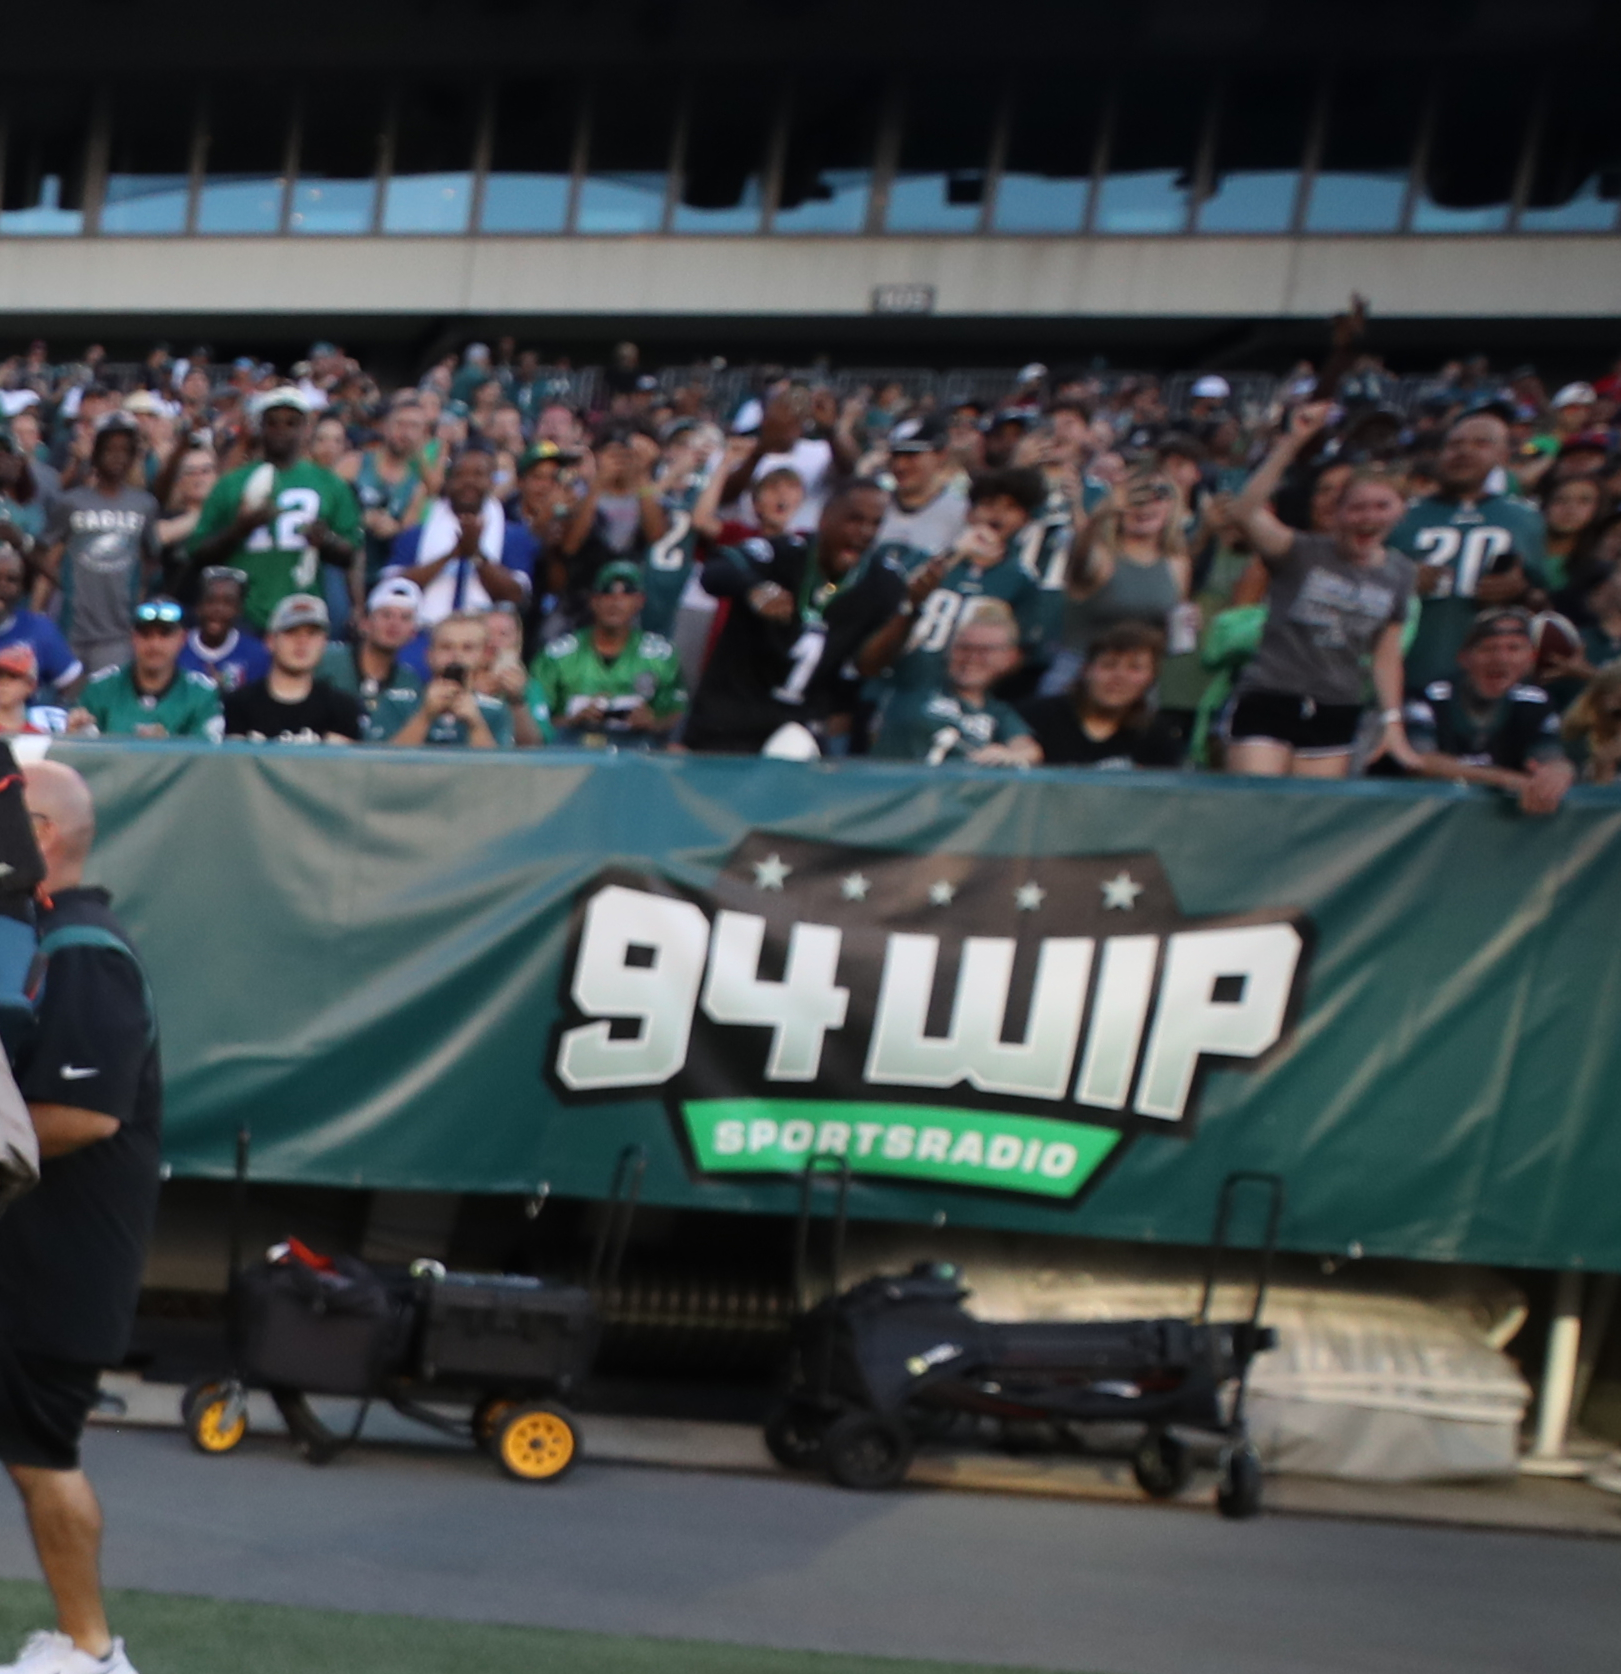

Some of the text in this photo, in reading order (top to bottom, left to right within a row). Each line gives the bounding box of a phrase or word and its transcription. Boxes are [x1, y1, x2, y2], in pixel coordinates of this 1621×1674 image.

[771, 632, 828, 705] 1
[556, 884, 1304, 1122] 94 WIP
[713, 1118, 1079, 1178] SPORTSRADIO
